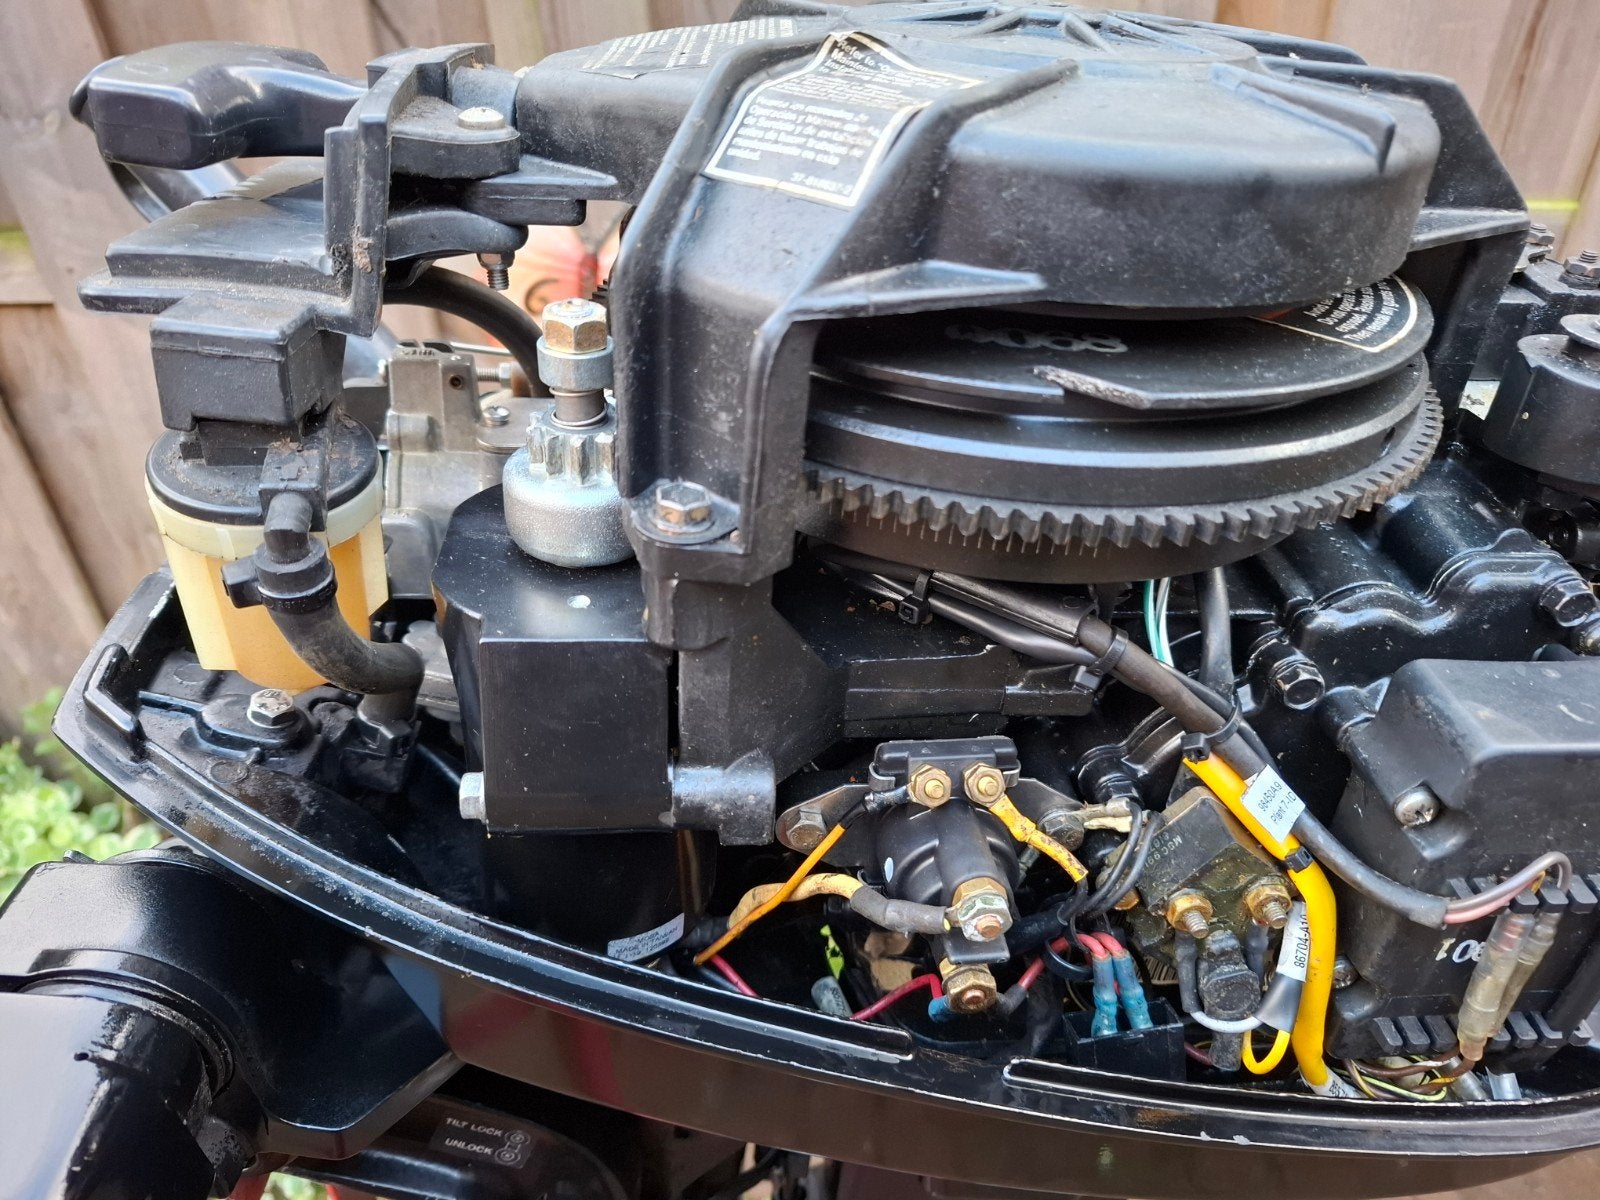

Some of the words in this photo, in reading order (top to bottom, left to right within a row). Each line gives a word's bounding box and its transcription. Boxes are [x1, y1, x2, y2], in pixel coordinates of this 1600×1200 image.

[837, 40, 864, 60] Refer
[446, 1117, 469, 1129] TILT
[470, 1123, 504, 1137] LOCK
[445, 1137, 494, 1156] UNLOCK
